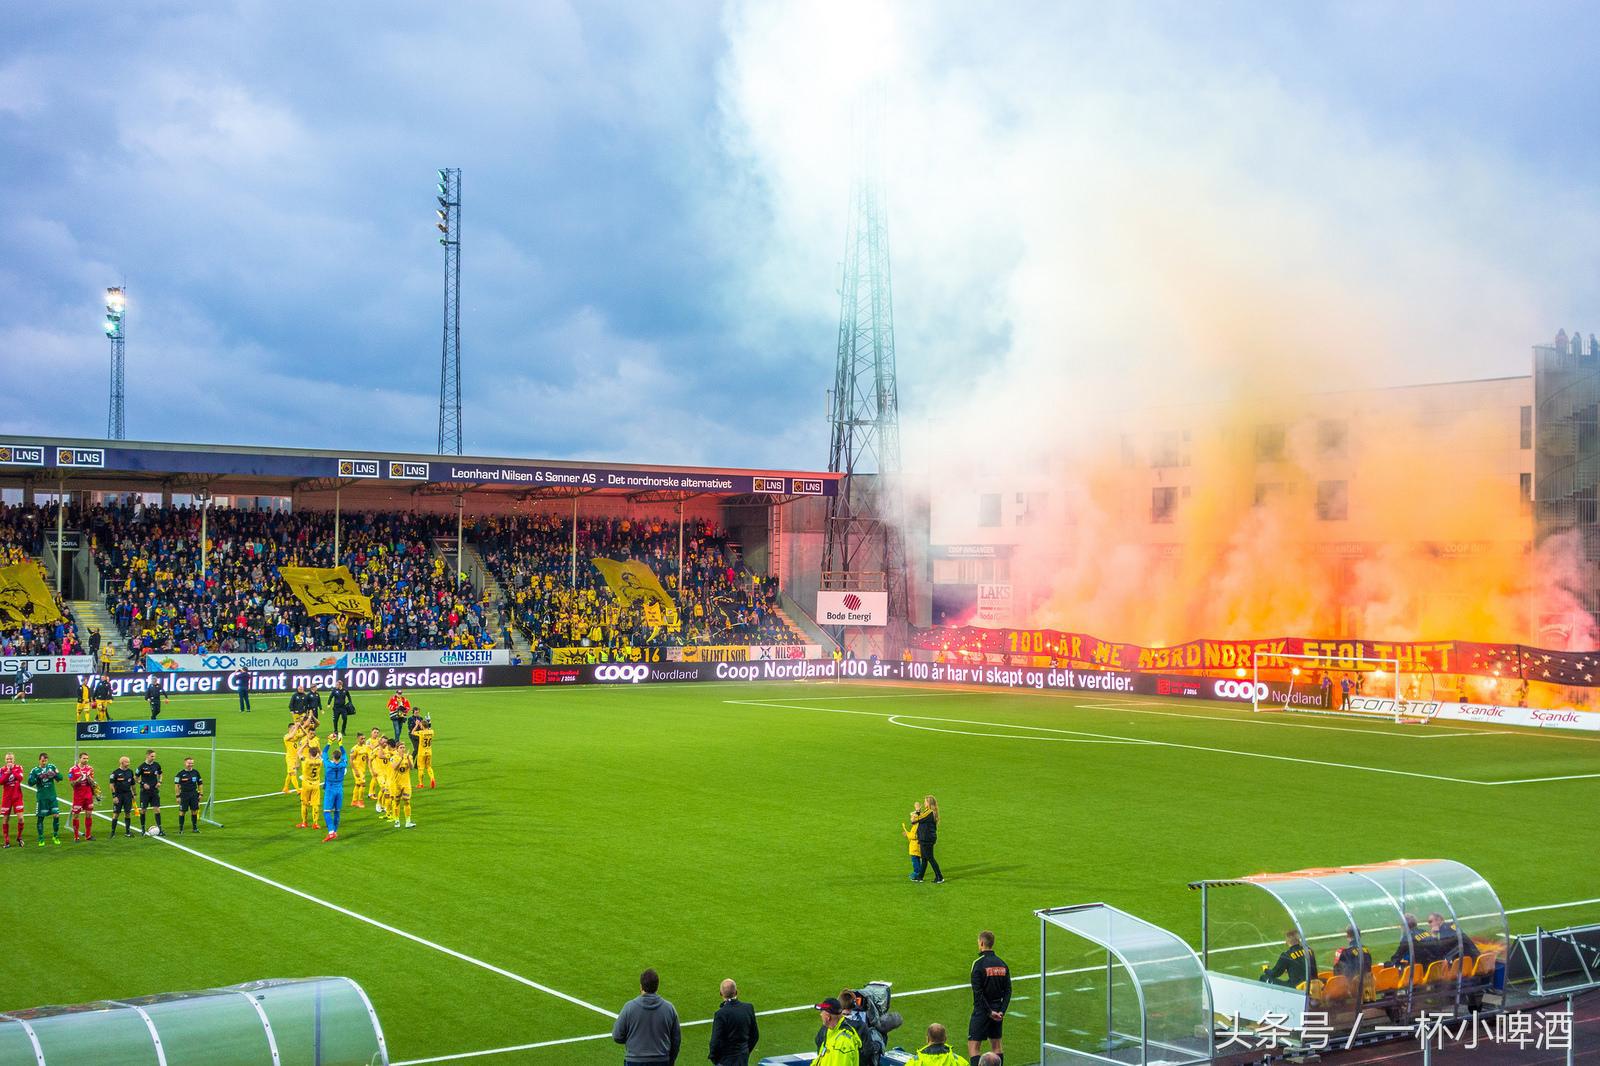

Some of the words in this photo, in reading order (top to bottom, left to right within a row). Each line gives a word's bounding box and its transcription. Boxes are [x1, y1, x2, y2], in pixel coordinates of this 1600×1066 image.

[16, 451, 39, 460] LNS
[77, 453, 100, 462] LNS
[356, 464, 376, 473] LNS
[406, 466, 425, 475] LNS
[451, 467, 499, 476] Leonhard
[501, 470, 533, 481] Nilsen
[535, 472, 543, 481] &
[545, 472, 580, 484] Sønner
[582, 474, 596, 484] AS
[608, 475, 625, 484] Det
[627, 477, 679, 487] nordnorske
[681, 478, 732, 488] alternativet
[766, 482, 782, 490] LNS
[805, 483, 820, 491] LNS
[848, 612, 871, 621] Energi
[1008, 631, 1042, 652] 100
[1059, 634, 1081, 658] ÅR
[355, 652, 407, 663] HANESETH
[443, 651, 492, 661] HANESETH
[240, 657, 269, 667] Salten
[272, 656, 298, 668] Aqua
[652, 669, 698, 680] Nordland
[716, 663, 760, 680] Coop
[764, 659, 835, 678] Nordland
[840, 661, 867, 676] 100
[873, 660, 891, 676] år
[907, 663, 928, 679] 100
[932, 663, 945, 680] år
[947, 664, 968, 681] har
[971, 666, 983, 682] vi
[986, 668, 1022, 687] skapt
[1026, 674, 1043, 688] og
[1047, 669, 1075, 687] delt
[1078, 673, 1134, 691] verdier.
[110, 671, 221, 696] gratulerer
[292, 670, 337, 689] med
[344, 669, 379, 688] 100
[385, 667, 484, 688] årsdagen!
[1272, 691, 1322, 705] Nordland
[1458, 705, 1505, 717] Scandic
[1530, 710, 1581, 722] Scandic
[111, 726, 138, 734] TIPPE
[150, 725, 184, 733] LIGAEN
[311, 768, 317, 778] 5
